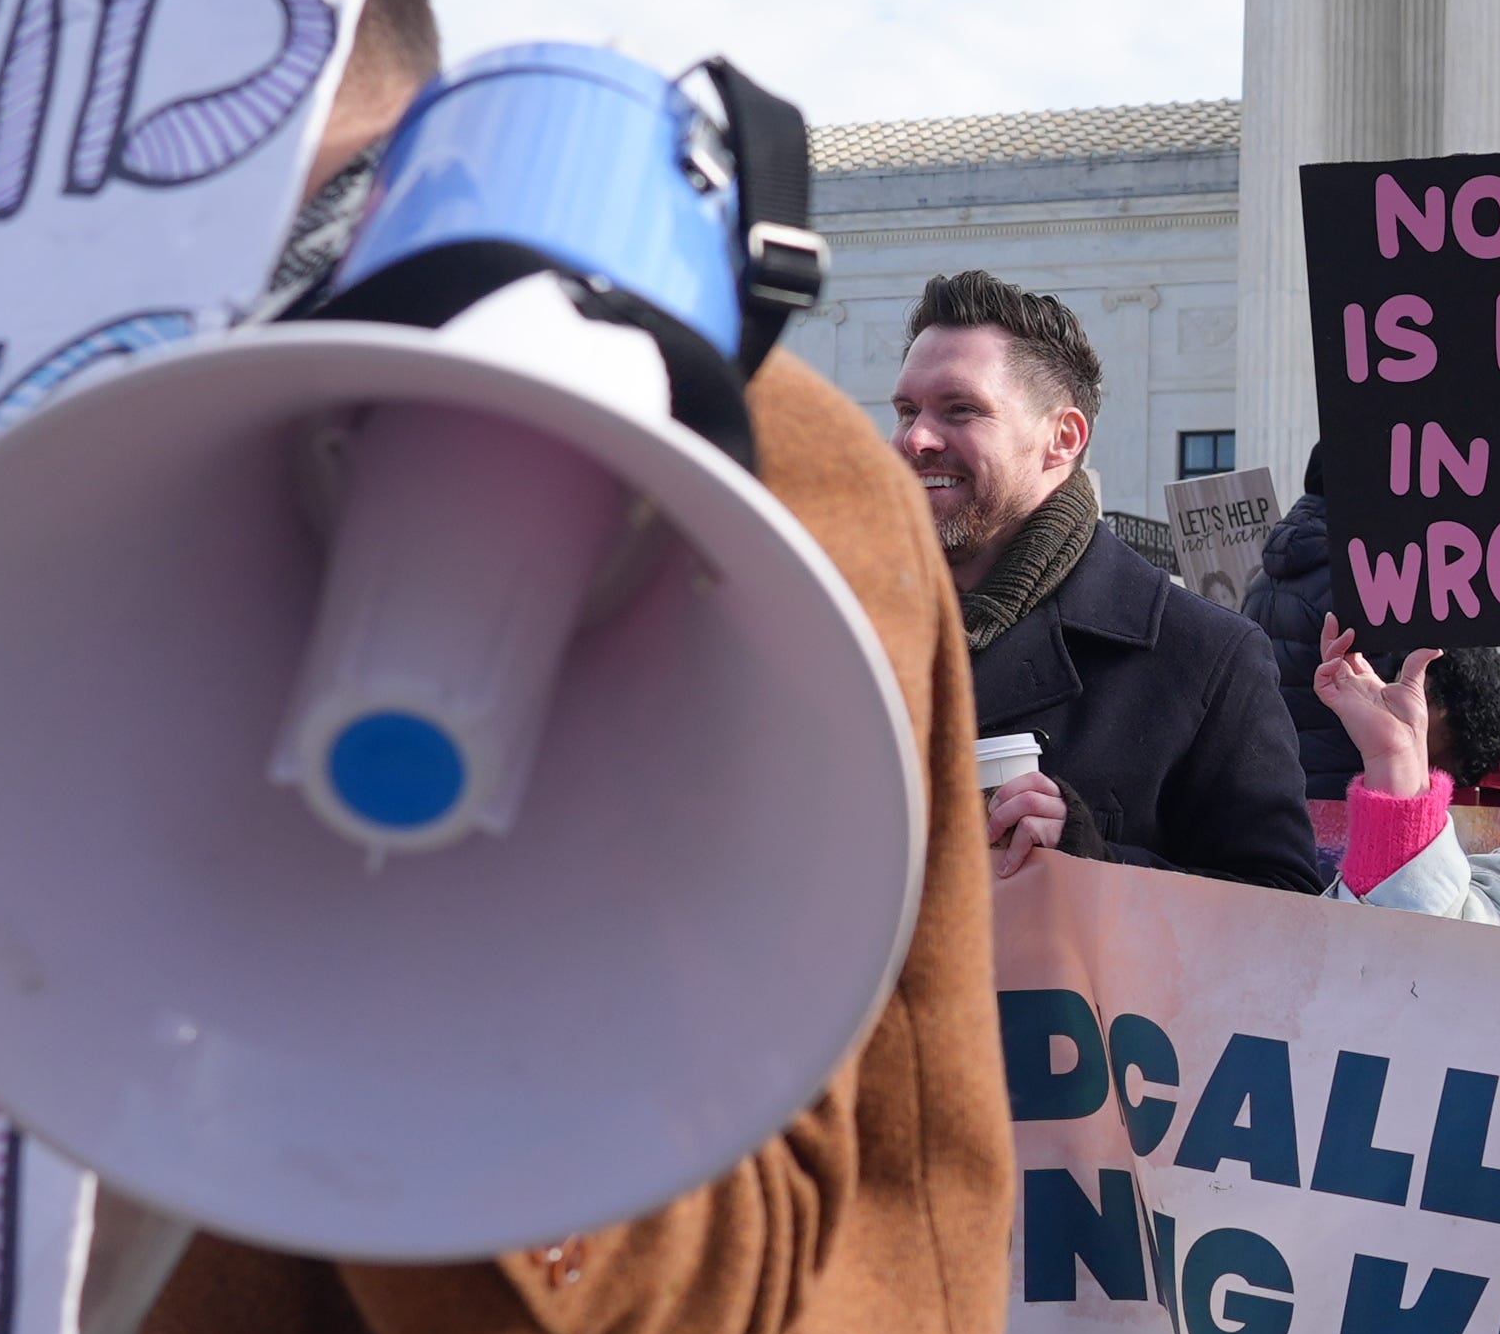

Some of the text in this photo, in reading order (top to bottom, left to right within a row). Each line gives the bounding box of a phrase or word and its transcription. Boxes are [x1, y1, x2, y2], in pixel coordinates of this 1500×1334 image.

[1342, 293, 1439, 384] IS
[1389, 420, 1490, 498] IN
[1178, 497, 1269, 537] LET'S HELP
[1181, 527, 1214, 553] not
